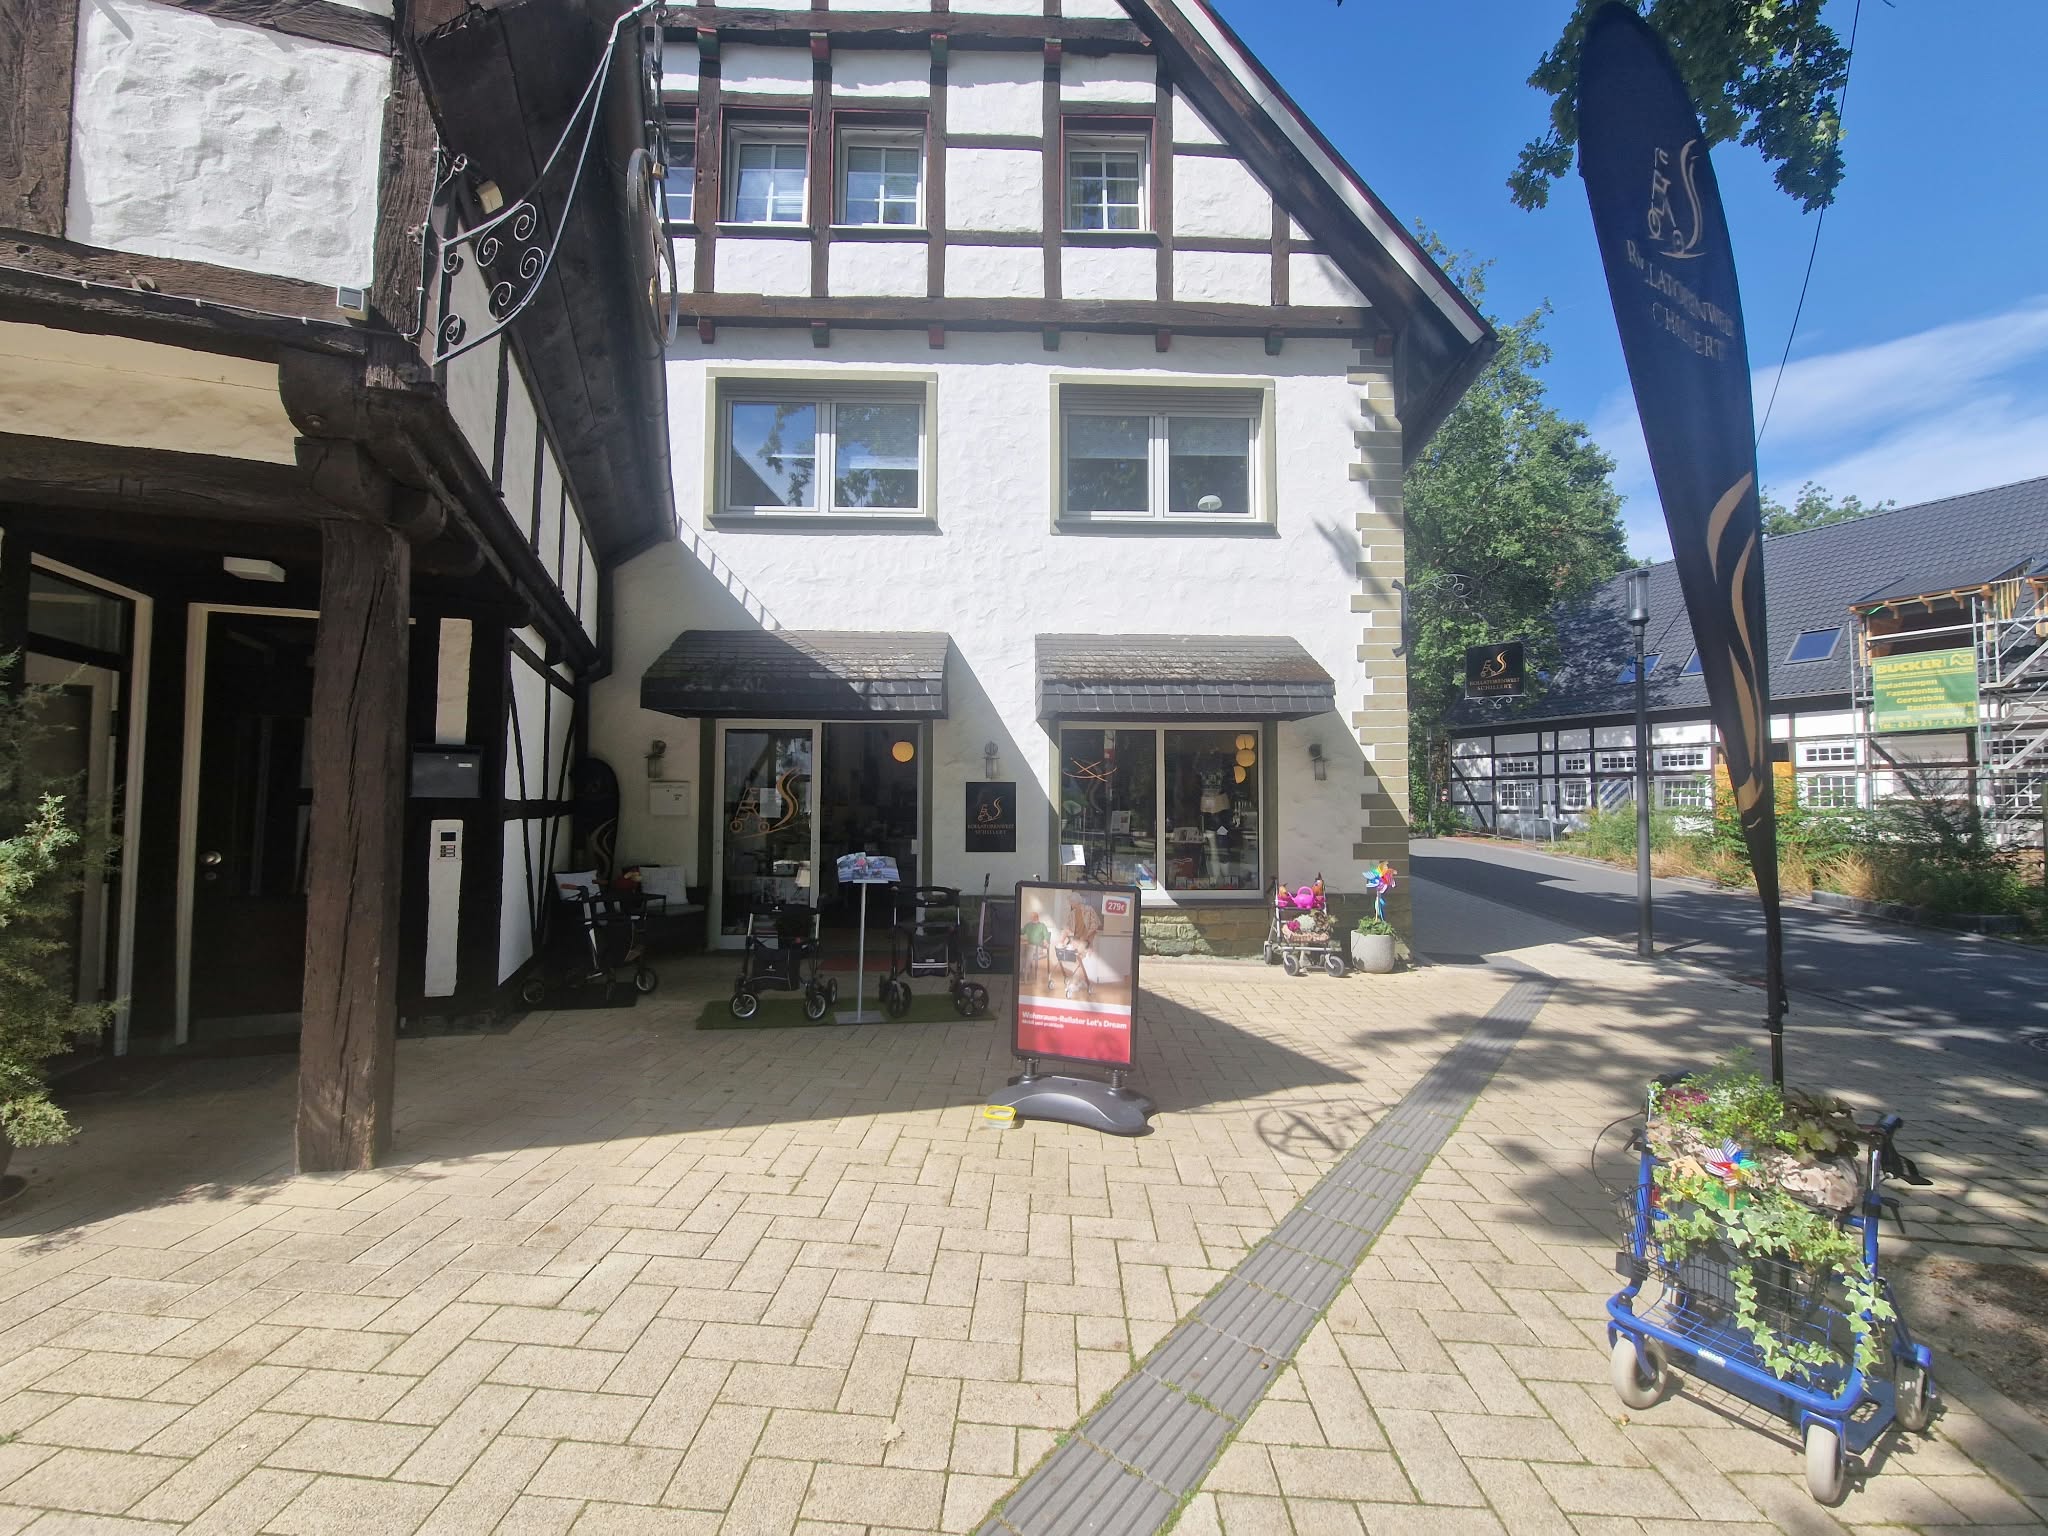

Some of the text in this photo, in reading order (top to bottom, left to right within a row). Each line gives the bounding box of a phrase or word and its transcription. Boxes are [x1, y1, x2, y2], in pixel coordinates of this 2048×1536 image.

[1886, 687, 1945, 697] Fassadenbau
[1086, 1017, 1103, 1027] Let's
[1103, 1019, 1127, 1030] Dream
